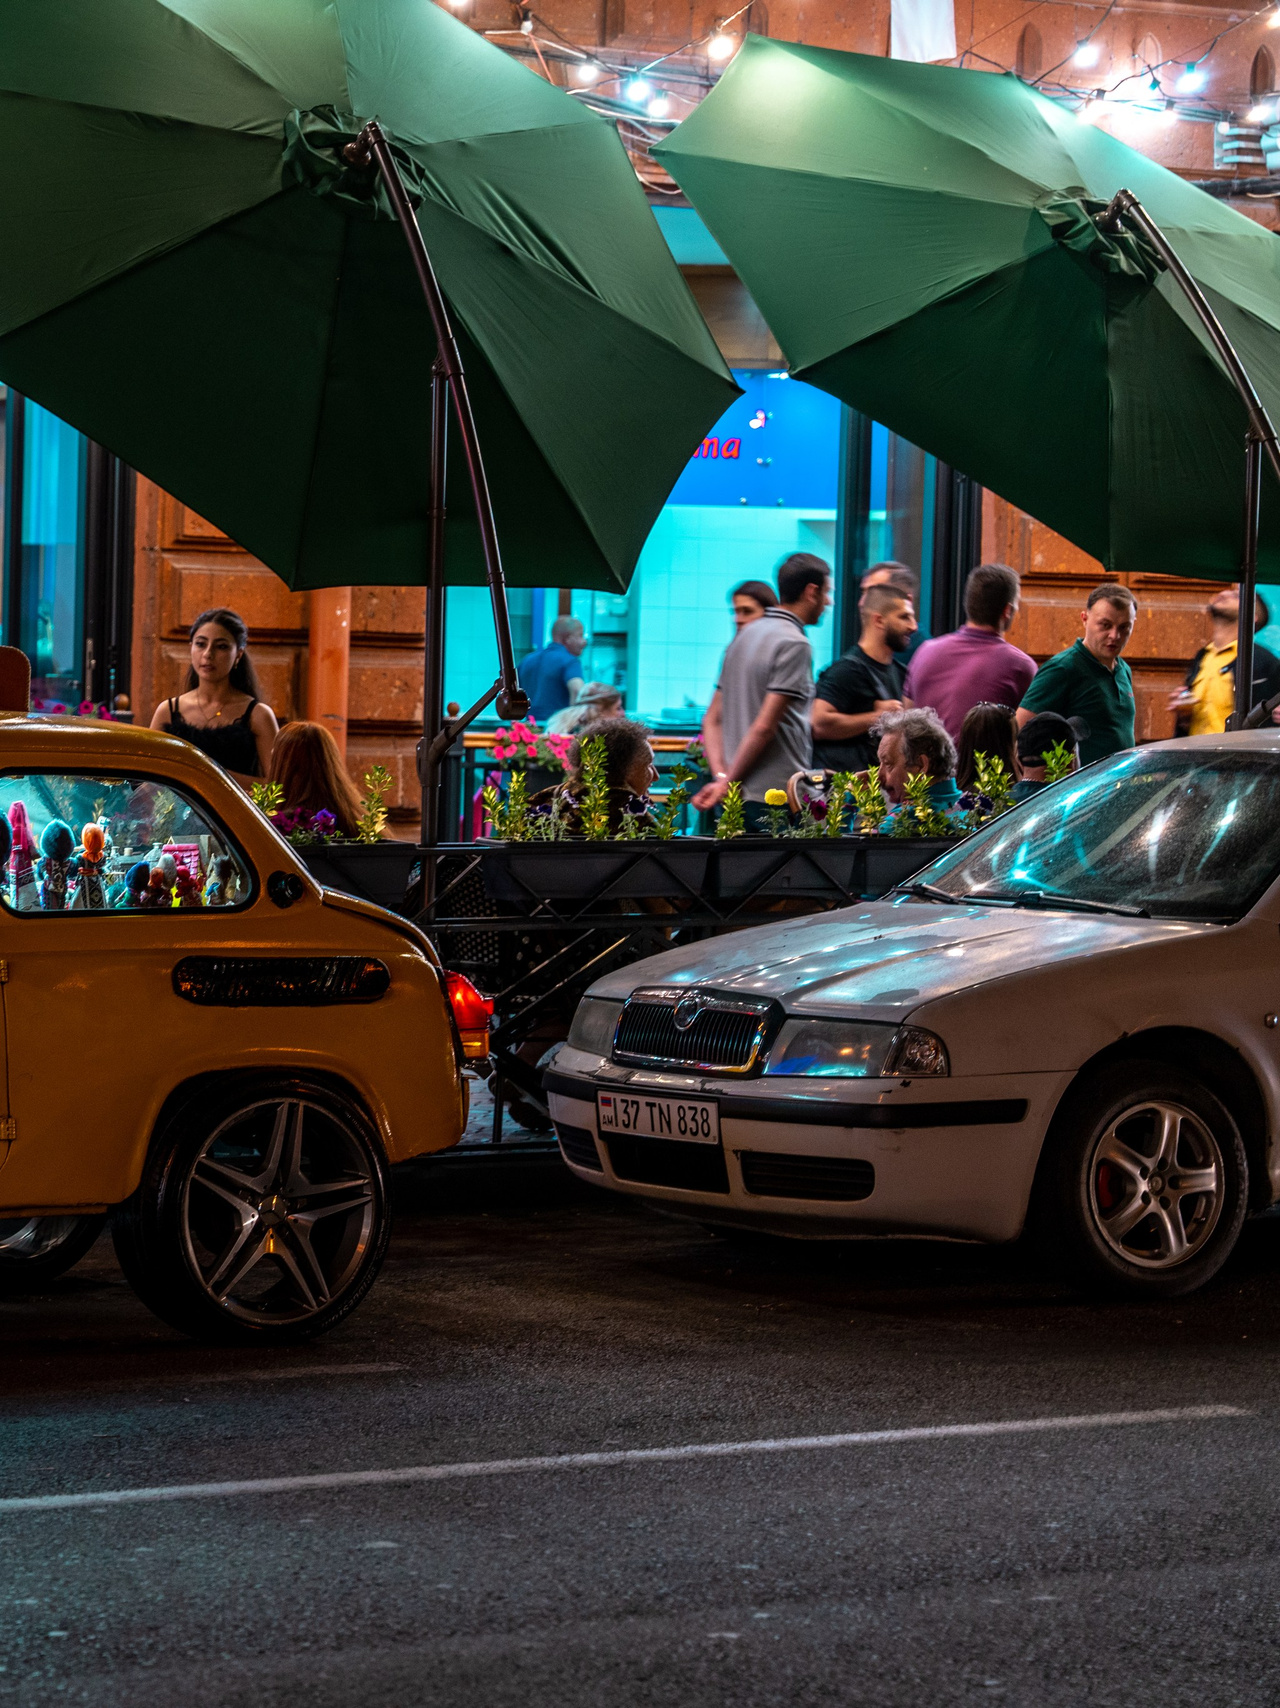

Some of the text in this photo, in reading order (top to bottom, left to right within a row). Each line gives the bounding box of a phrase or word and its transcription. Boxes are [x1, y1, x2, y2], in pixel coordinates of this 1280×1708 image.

[692, 436, 742, 459] ma
[602, 1098, 711, 1138] AM 37 TN 838
